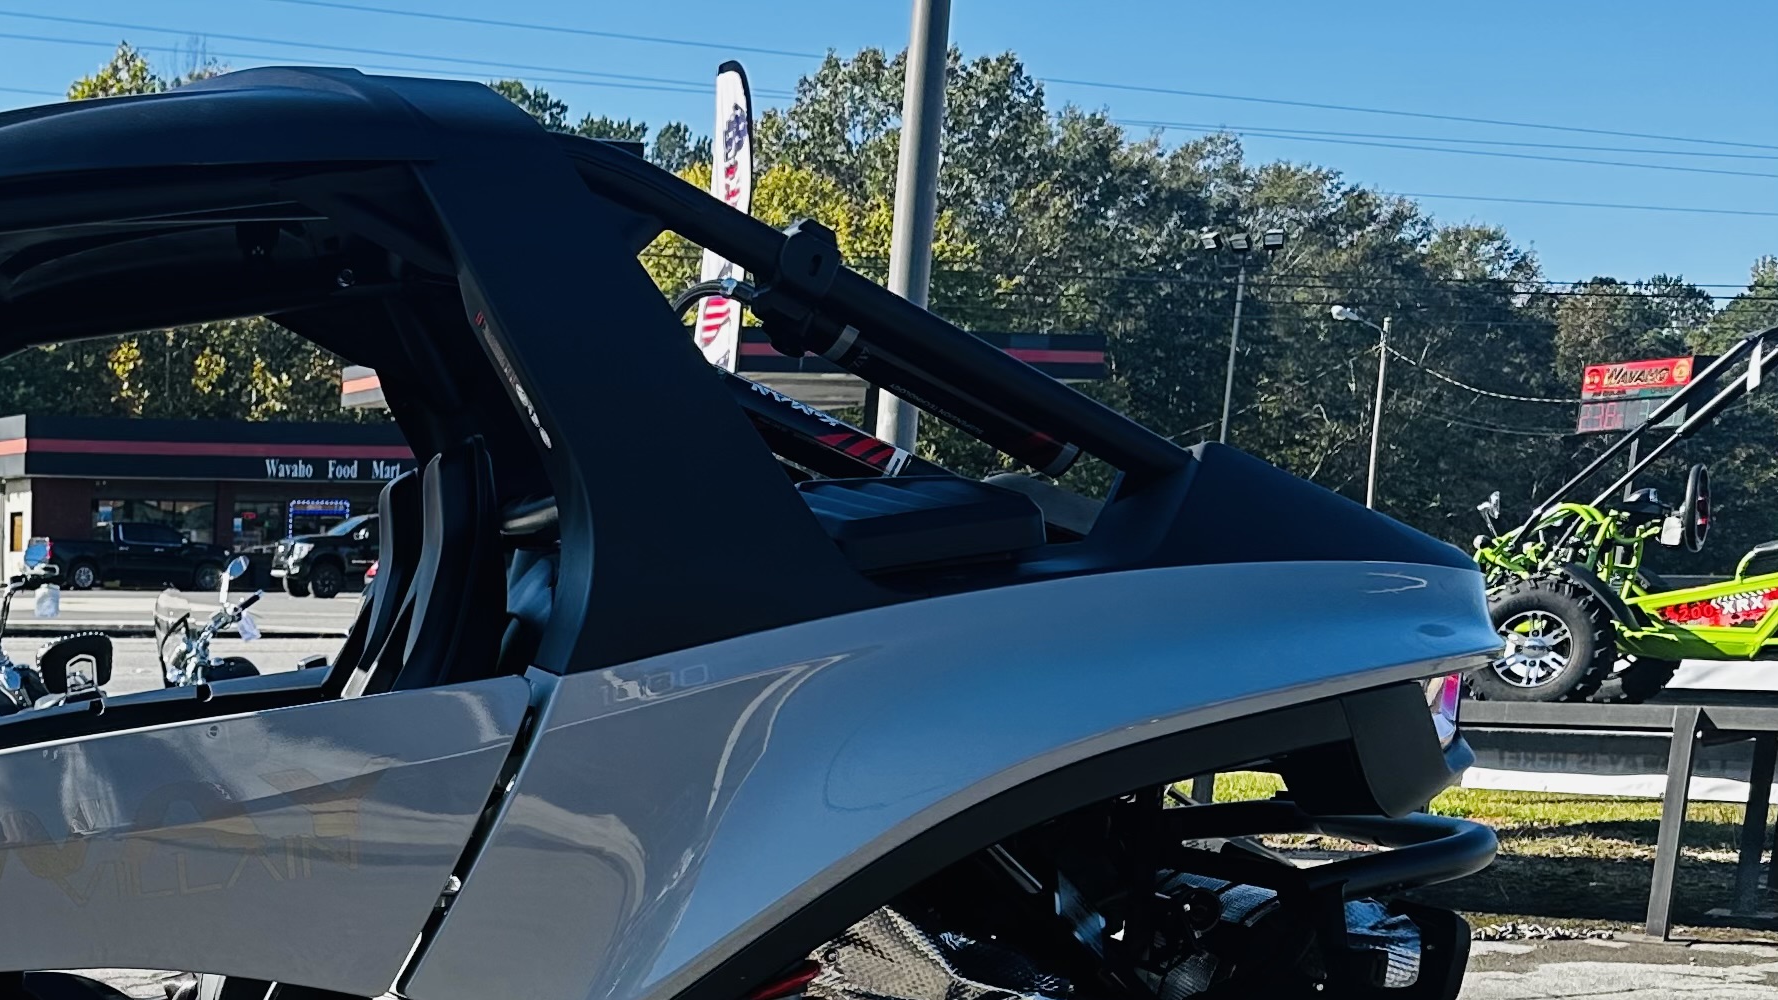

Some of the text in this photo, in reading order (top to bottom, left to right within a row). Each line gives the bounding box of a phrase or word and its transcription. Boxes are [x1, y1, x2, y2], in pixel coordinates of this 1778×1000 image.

[265, 458, 401, 479] Wavaho Food Mart
[1722, 595, 1764, 615] XRX
[51, 832, 360, 908] VILLAIN
